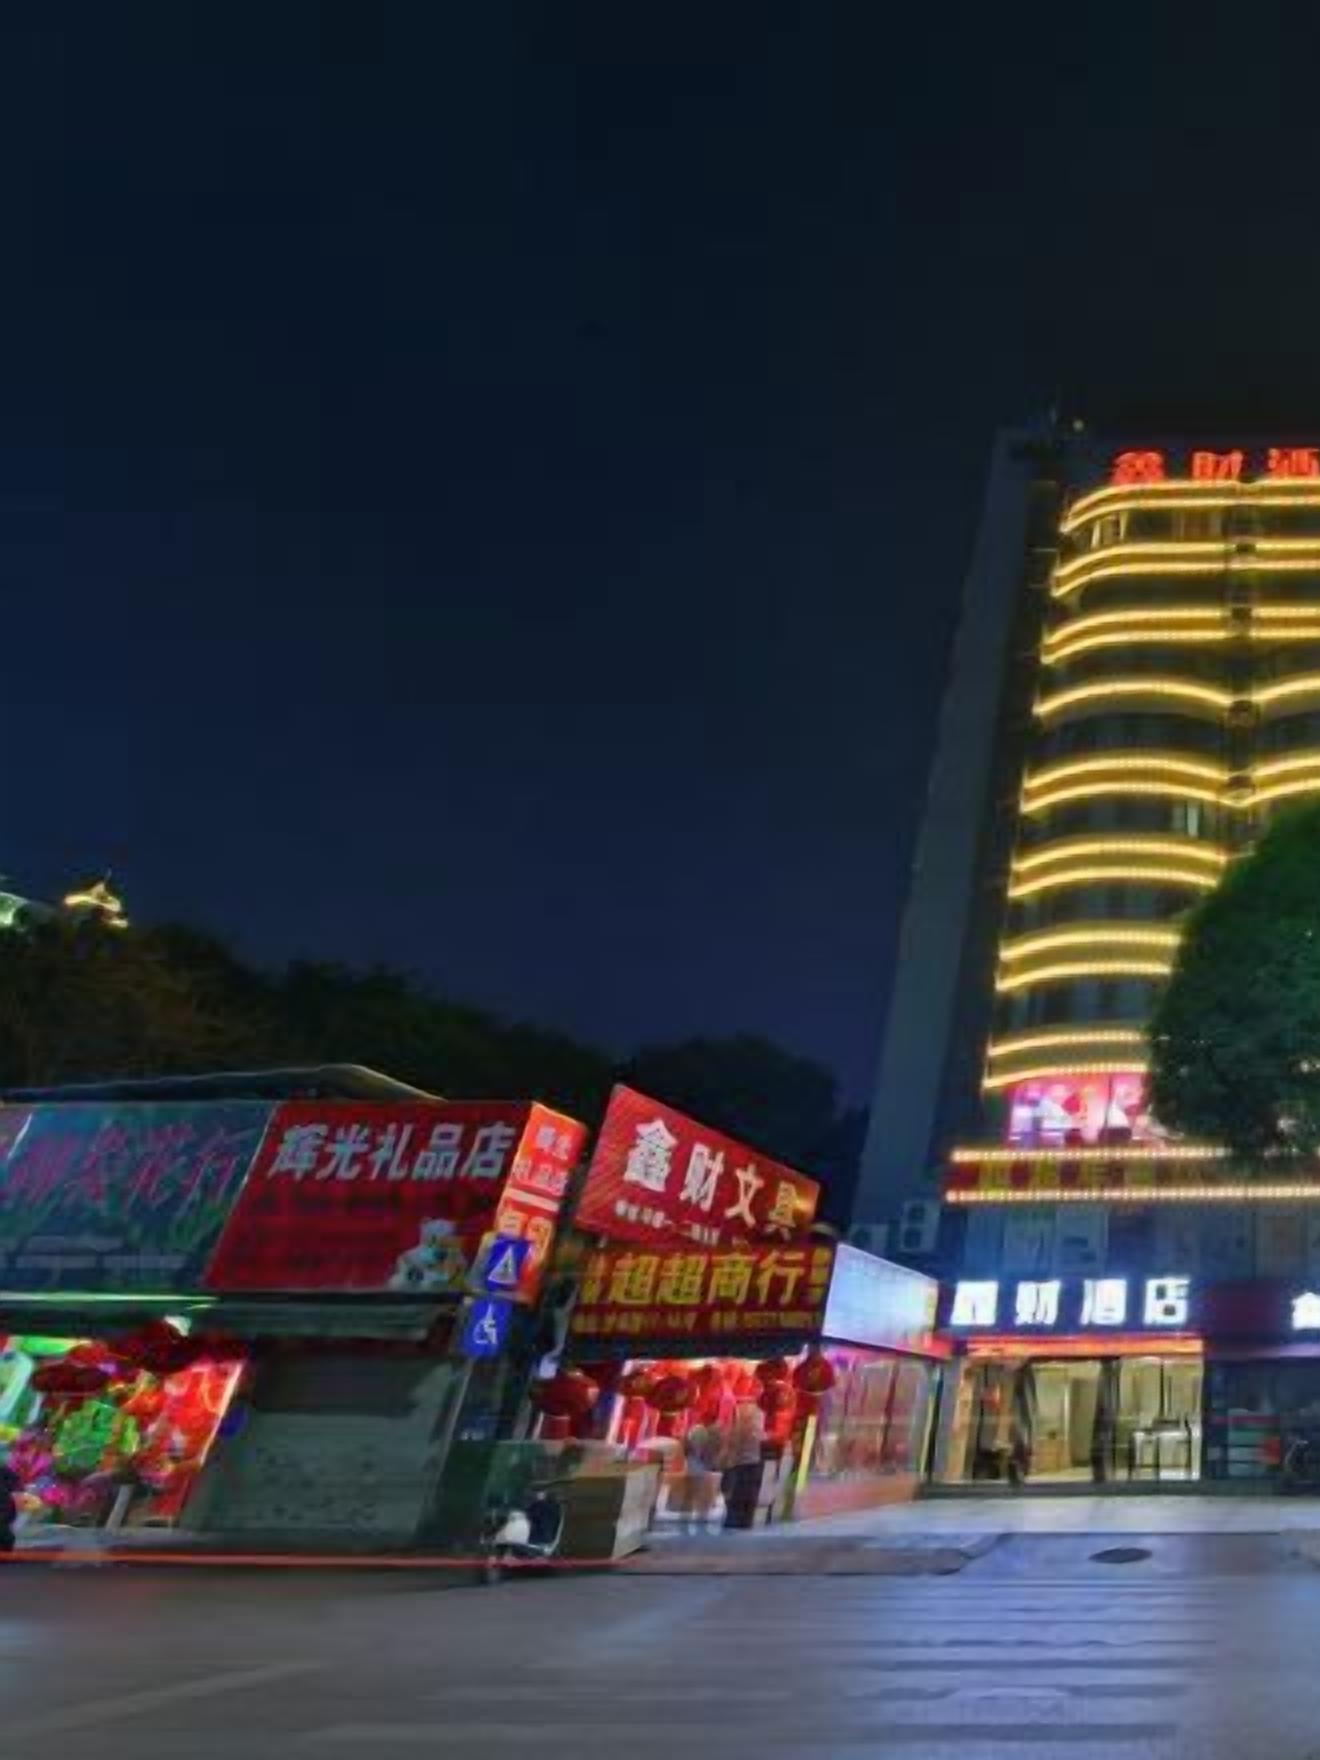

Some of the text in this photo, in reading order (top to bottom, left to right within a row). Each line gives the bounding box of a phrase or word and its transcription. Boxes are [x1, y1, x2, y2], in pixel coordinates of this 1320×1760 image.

[268, 1121, 516, 1181] 辉光礼品店
[622, 1118, 799, 1240] 鑫财文具
[950, 1277, 1191, 1325] 鑫财酒店
